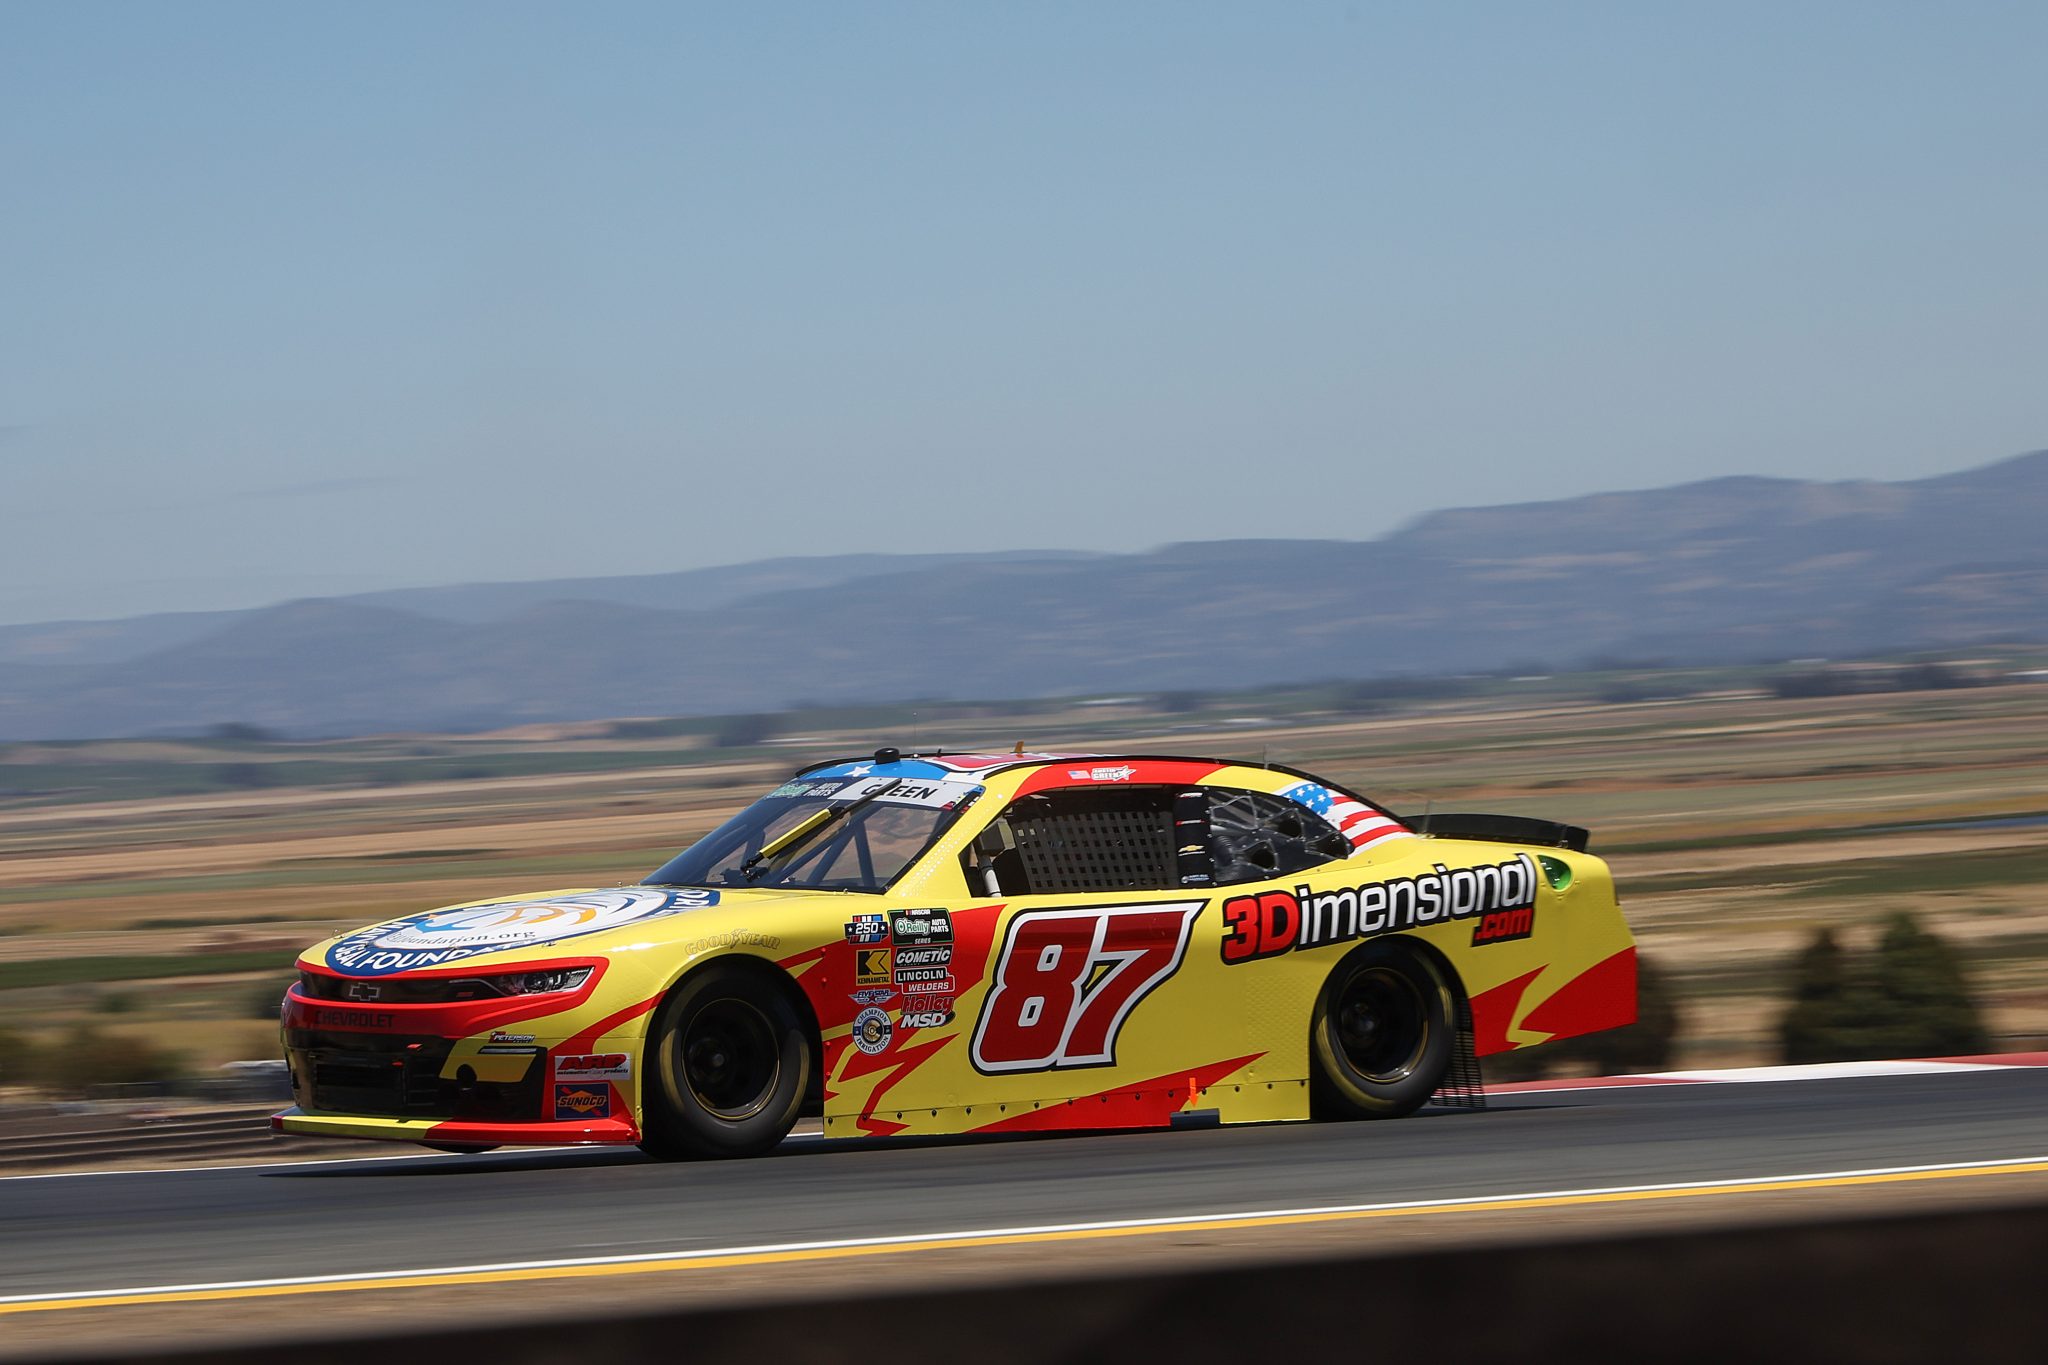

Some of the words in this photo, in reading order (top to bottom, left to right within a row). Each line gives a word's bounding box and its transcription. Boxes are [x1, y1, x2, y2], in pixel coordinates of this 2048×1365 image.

[860, 784, 939, 800] GEEN
[1222, 852, 1537, 964] 3Dimensional
[855, 922, 879, 934] 250
[930, 925, 949, 933] PARTS
[931, 918, 946, 926] AUTO
[1474, 907, 1534, 940] .com
[685, 929, 781, 955] GOODYEAR
[914, 937, 932, 945] SERIES
[896, 948, 951, 964] COMETIC
[897, 970, 944, 982] LINCOLN
[908, 982, 949, 992] WELDERS
[970, 900, 1208, 1074] 87
[901, 995, 955, 1016] Holley
[313, 1010, 396, 1028] CHEVROLET
[857, 1007, 889, 1025] CHAMPION
[900, 1012, 947, 1029] MSD
[856, 1036, 890, 1053] IRRIGATION
[557, 1054, 627, 1071] ARP
[559, 1095, 608, 1107] SUNOCO
